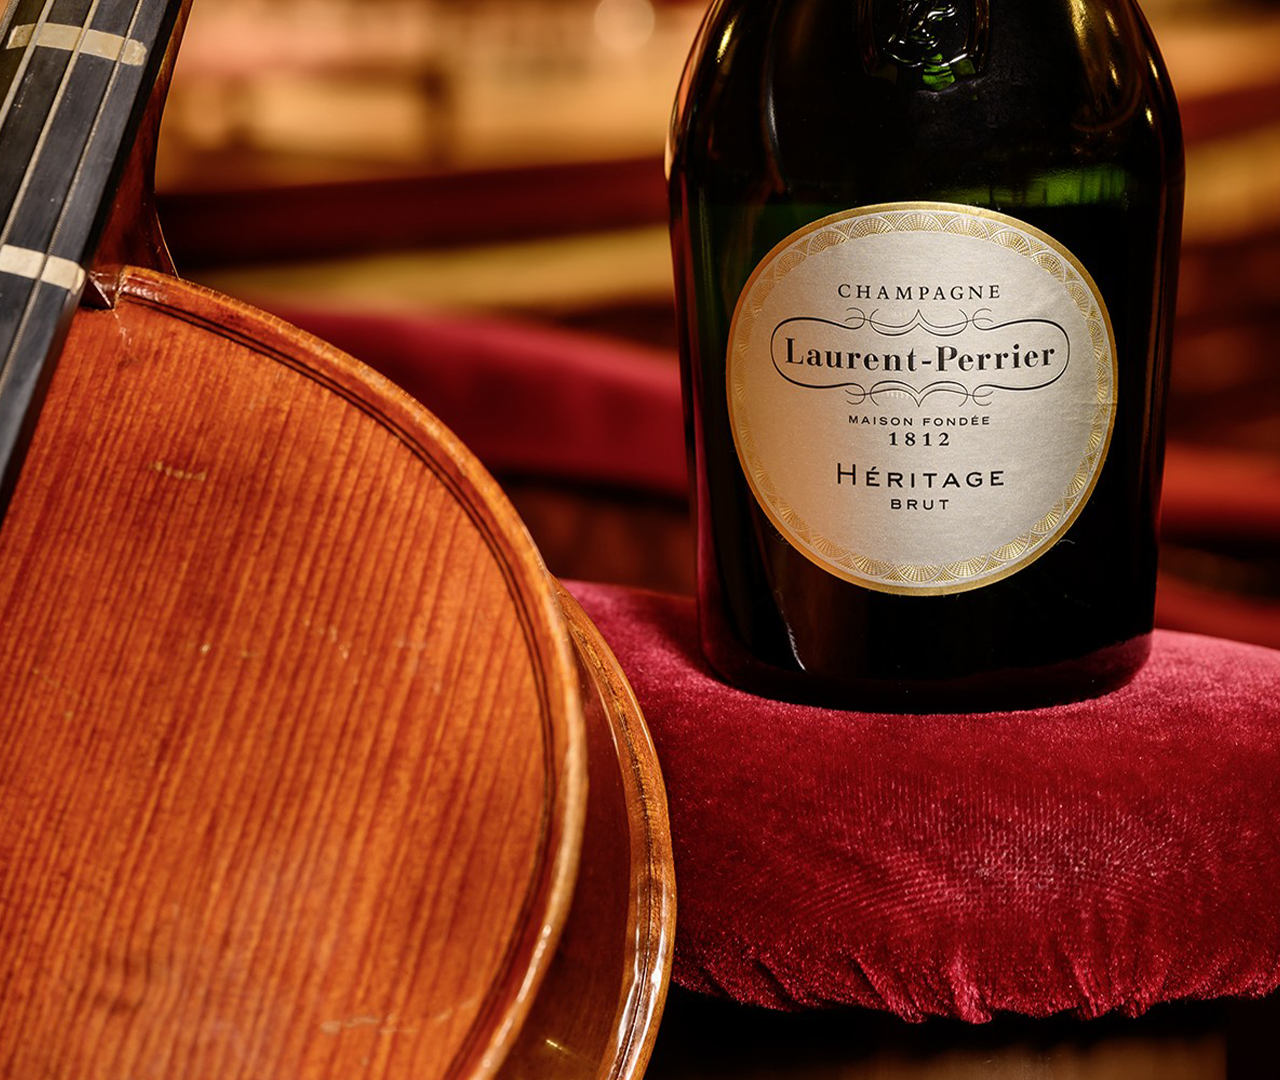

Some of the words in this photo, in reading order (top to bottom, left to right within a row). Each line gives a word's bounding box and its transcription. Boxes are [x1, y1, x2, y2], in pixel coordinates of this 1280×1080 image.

[837, 283, 1001, 301] CHAMPAGNE
[784, 337, 1056, 373] Laurent-Perrier
[848, 415, 913, 427] MAISON
[922, 415, 991, 427] FONDÉE
[888, 432, 951, 447] 1812
[836, 462, 1005, 488] HÉRITAGE
[890, 498, 950, 511] BRUT
